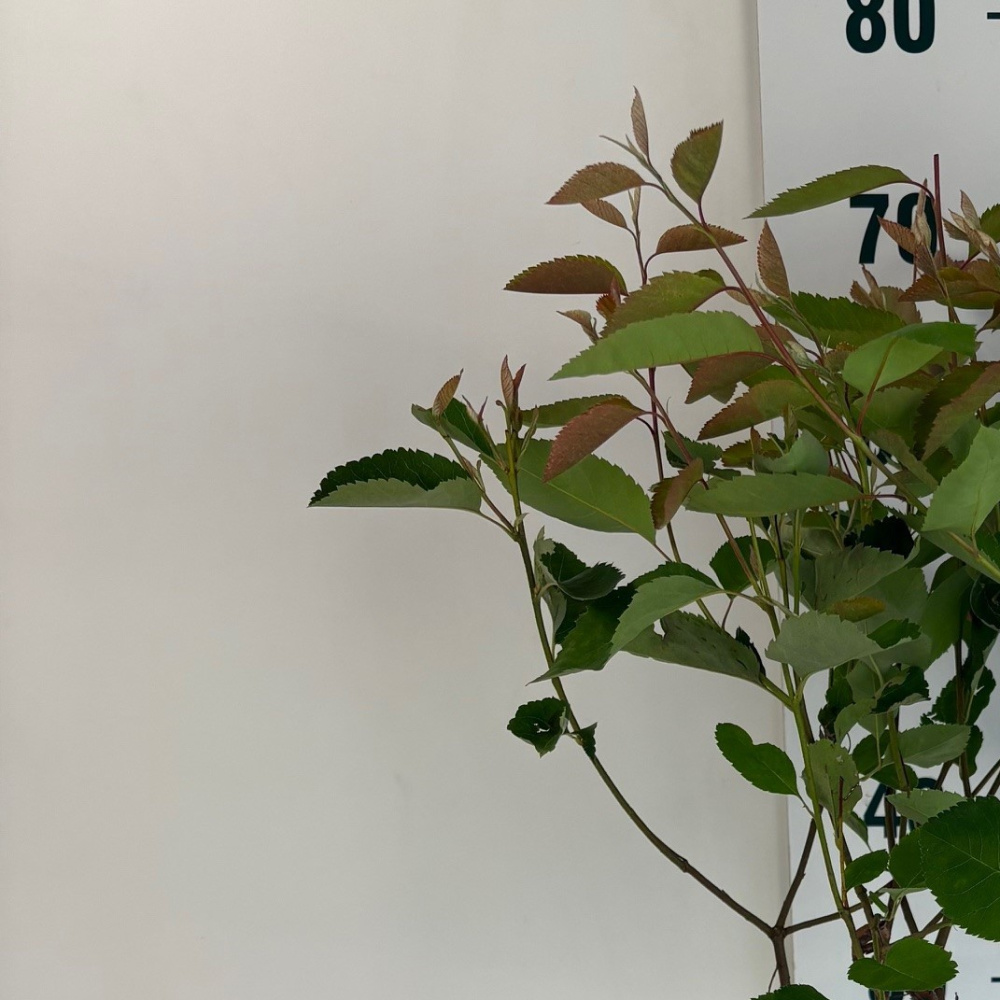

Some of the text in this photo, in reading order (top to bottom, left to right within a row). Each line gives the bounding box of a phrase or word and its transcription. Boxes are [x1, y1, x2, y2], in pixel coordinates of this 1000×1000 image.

[845, 0, 936, 54] 80
[849, 192, 938, 264] 70
[863, 777, 942, 838] 4
